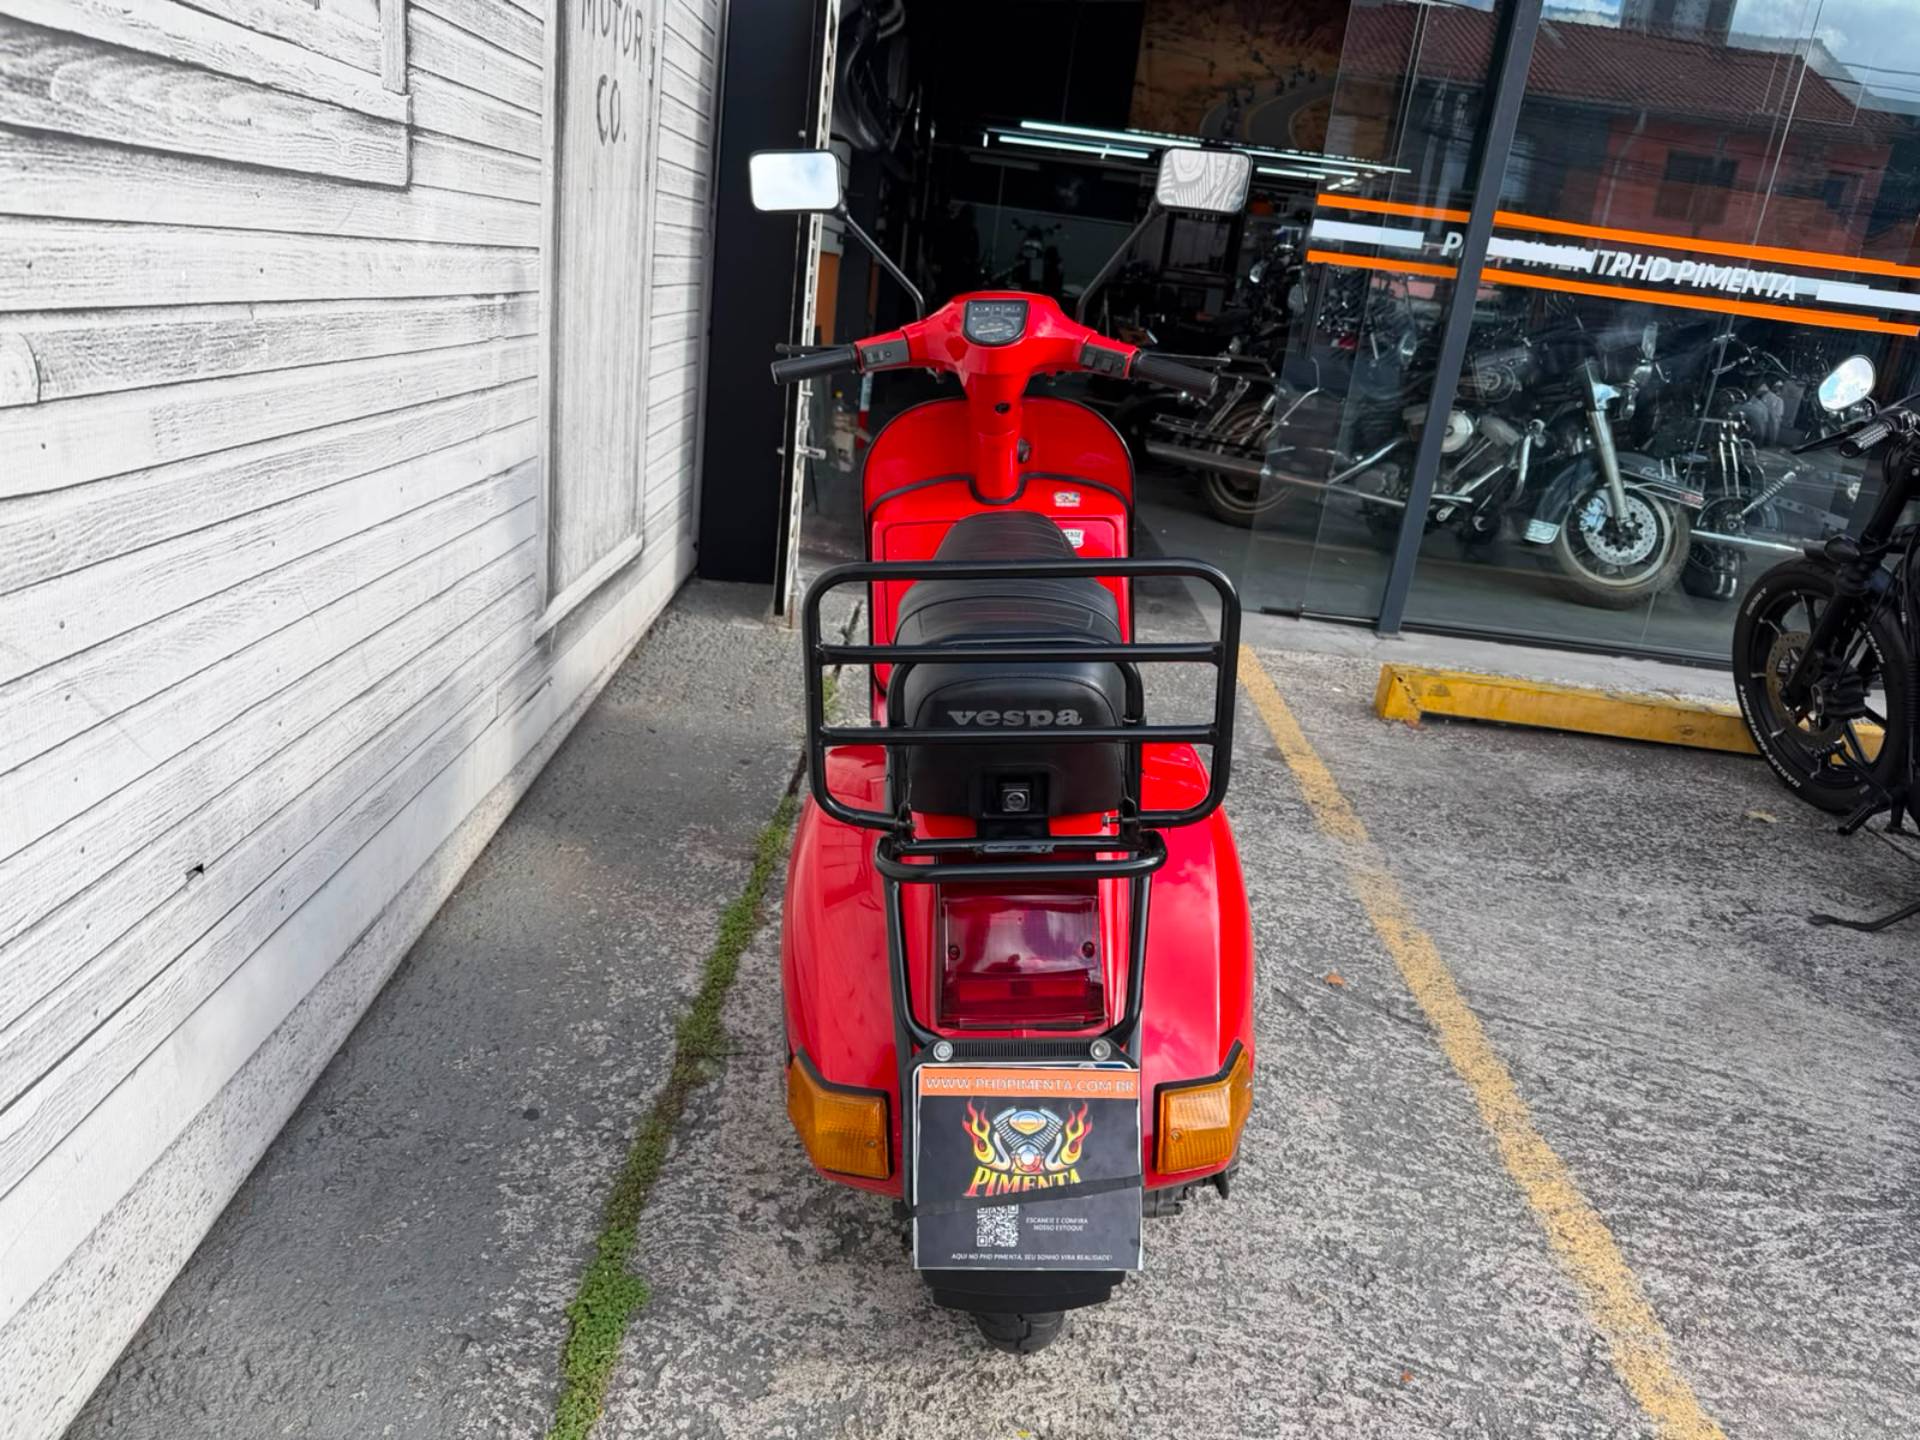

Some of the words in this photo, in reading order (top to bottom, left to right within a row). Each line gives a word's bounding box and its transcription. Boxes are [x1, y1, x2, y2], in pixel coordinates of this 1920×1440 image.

[596, 74, 626, 146] CO.
[1674, 260, 1797, 301] PIMENTA
[947, 709, 1083, 728] vespa
[962, 1165, 1082, 1197] PIMENTA
